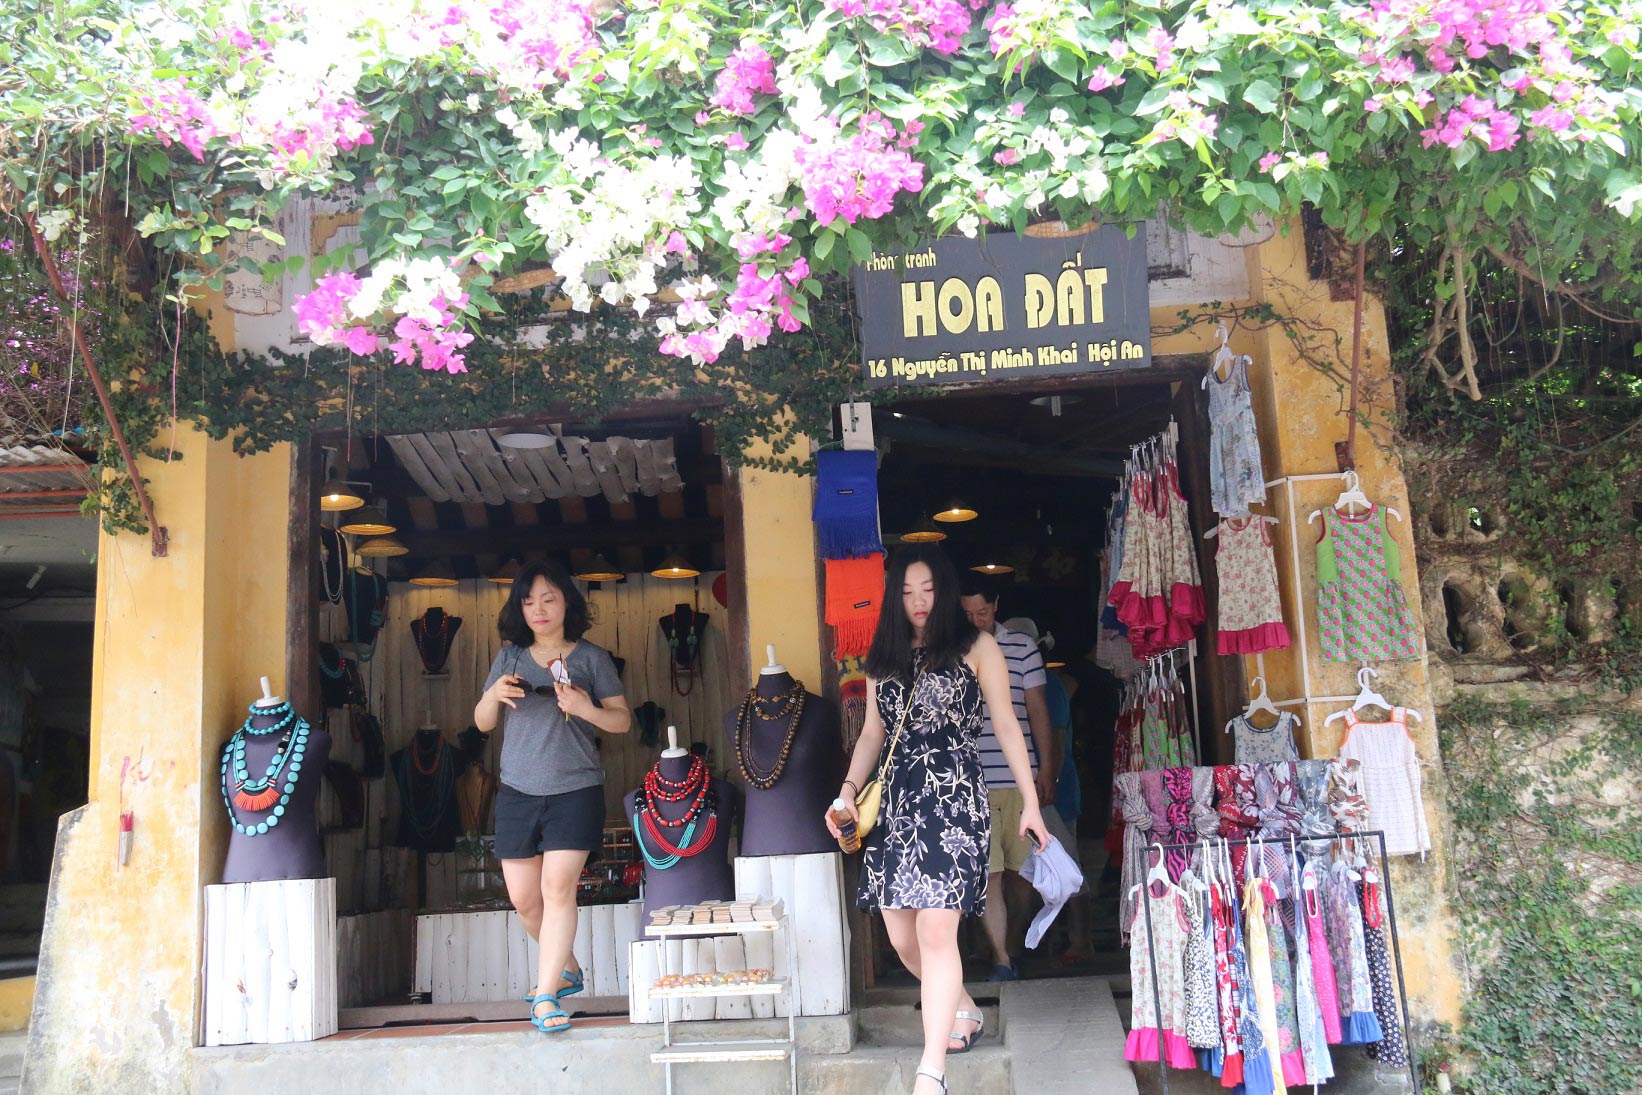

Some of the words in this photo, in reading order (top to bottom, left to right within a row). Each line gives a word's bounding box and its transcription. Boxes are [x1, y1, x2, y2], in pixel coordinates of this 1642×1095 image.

[866, 252, 899, 271] hòn
[905, 247, 936, 269] tranh
[901, 276, 1004, 338] HOA
[1024, 251, 1108, 329] ĐẤT
[868, 359, 887, 378] 16
[891, 352, 958, 380] Nguyễn
[960, 350, 986, 376] Thị
[991, 347, 1034, 369] Minh
[1037, 342, 1078, 366] Khai
[1088, 339, 1117, 366] Hội
[1121, 340, 1144, 360] An
